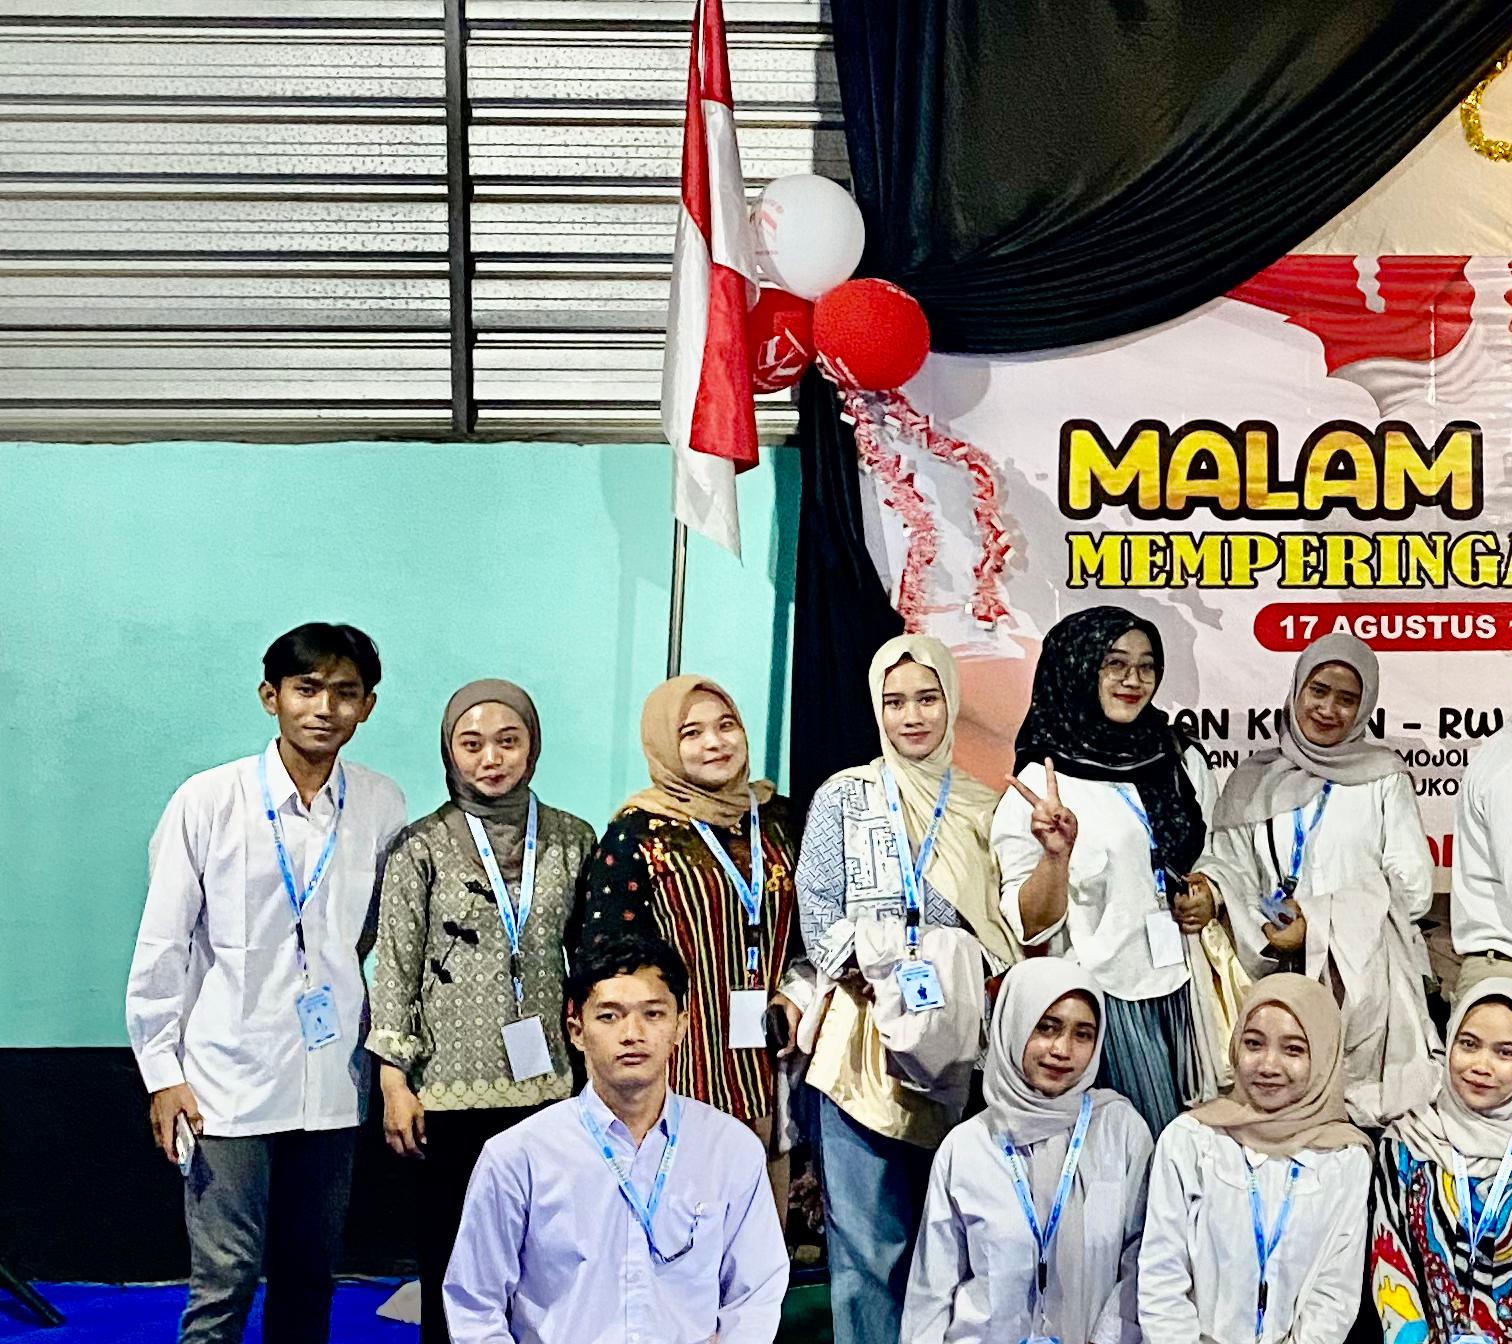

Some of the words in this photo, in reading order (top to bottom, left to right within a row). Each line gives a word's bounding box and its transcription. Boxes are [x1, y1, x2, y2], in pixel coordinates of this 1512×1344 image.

[1060, 420, 1483, 520] MALAM
[1279, 615, 1319, 640] 17
[1330, 615, 1497, 640] AGUSTUS
[1438, 707, 1504, 740] RW
